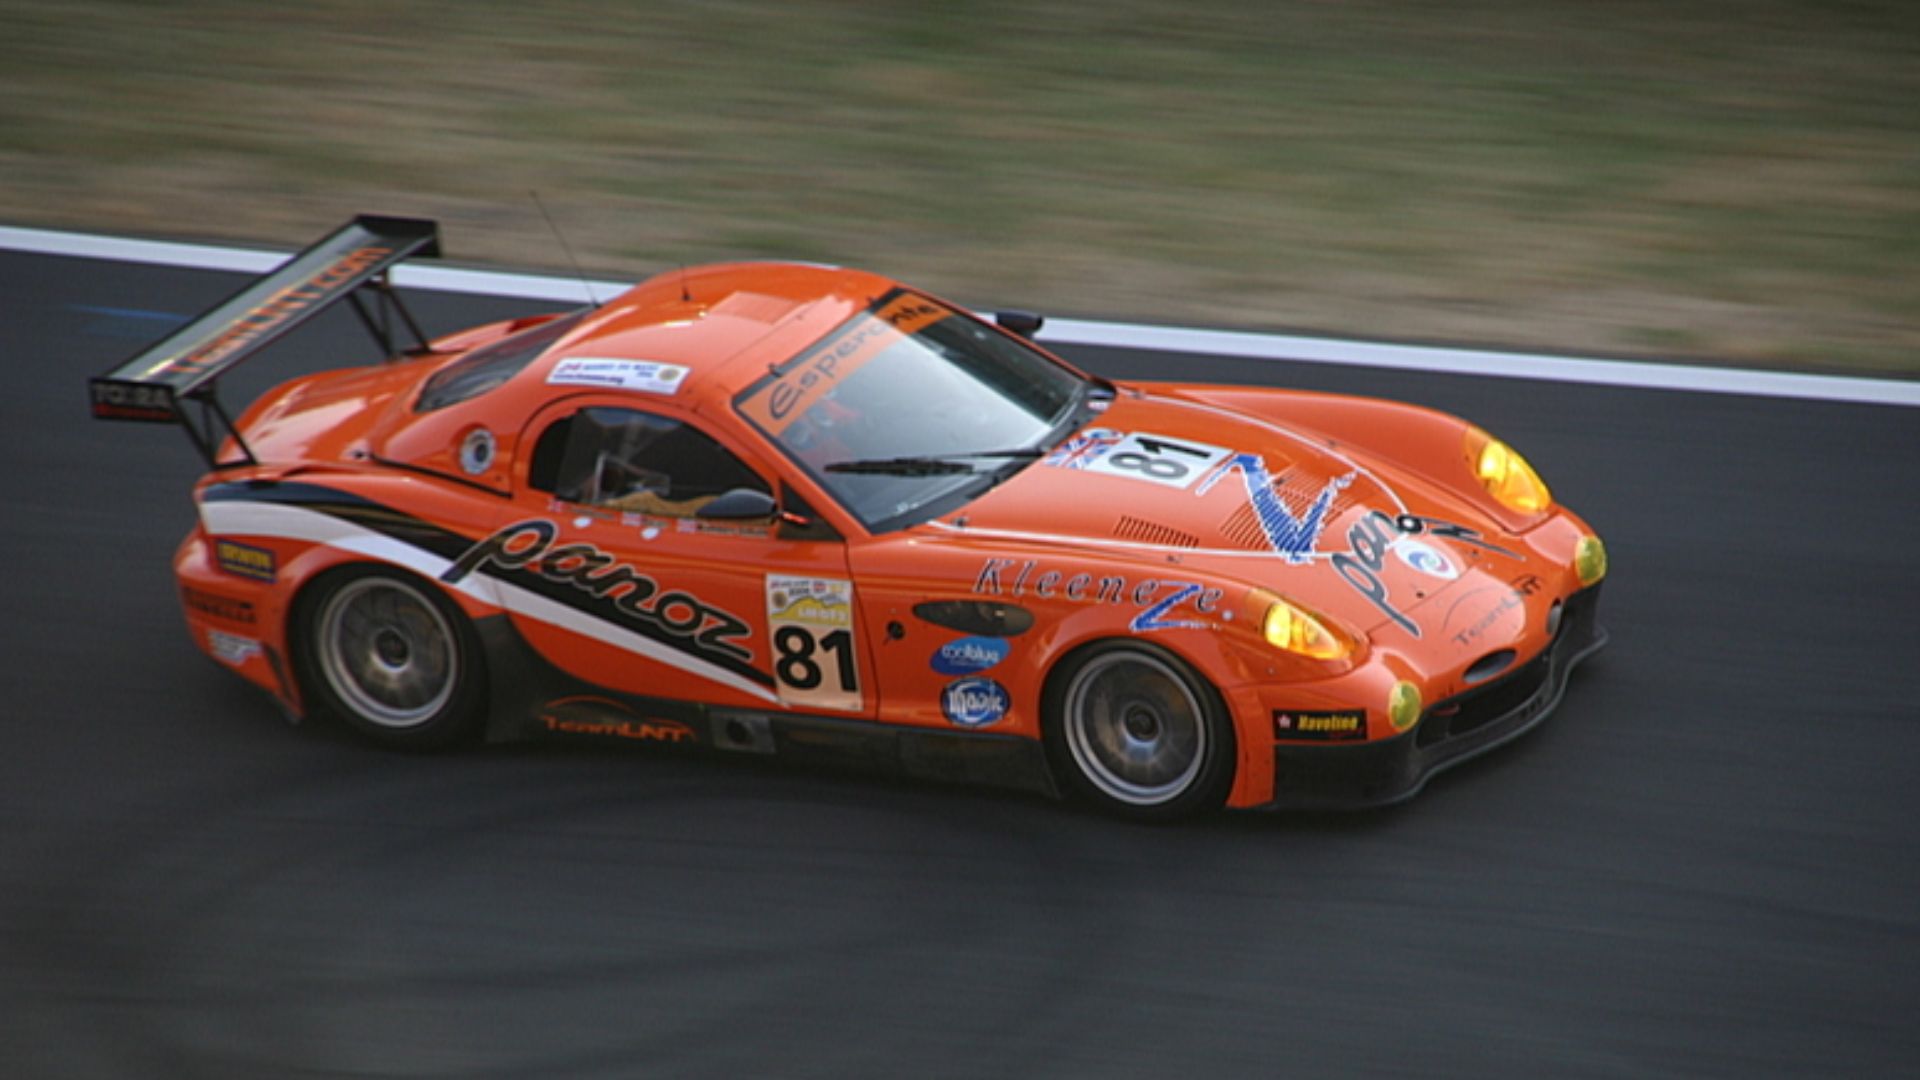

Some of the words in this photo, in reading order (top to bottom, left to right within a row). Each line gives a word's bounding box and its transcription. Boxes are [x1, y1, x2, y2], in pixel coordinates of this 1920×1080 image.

[768, 304, 940, 420] Esperante
[1108, 437, 1211, 478] 81
[774, 625, 857, 692] 81
